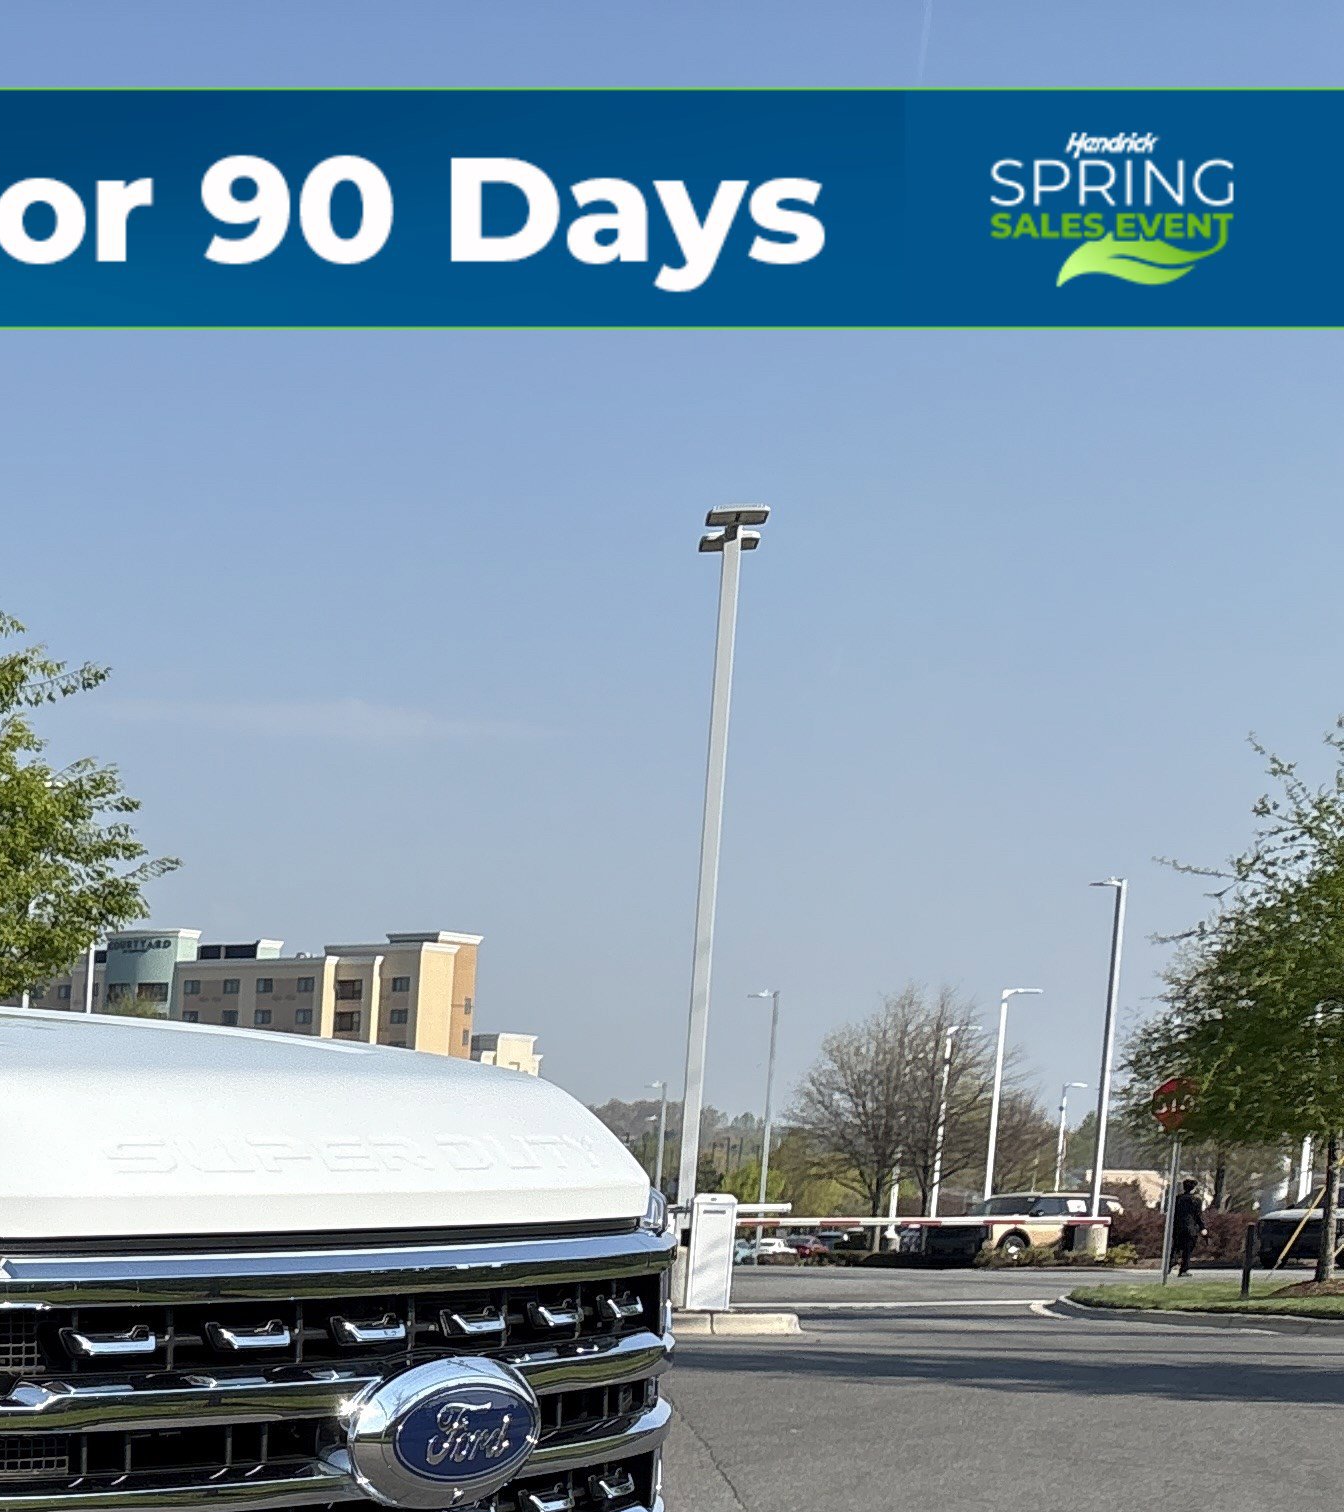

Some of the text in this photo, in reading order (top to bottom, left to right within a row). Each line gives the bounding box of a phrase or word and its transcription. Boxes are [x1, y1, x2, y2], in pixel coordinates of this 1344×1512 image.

[100, 1134, 600, 1174] SUPER DUTY
[425, 1401, 512, 1465] Ford
